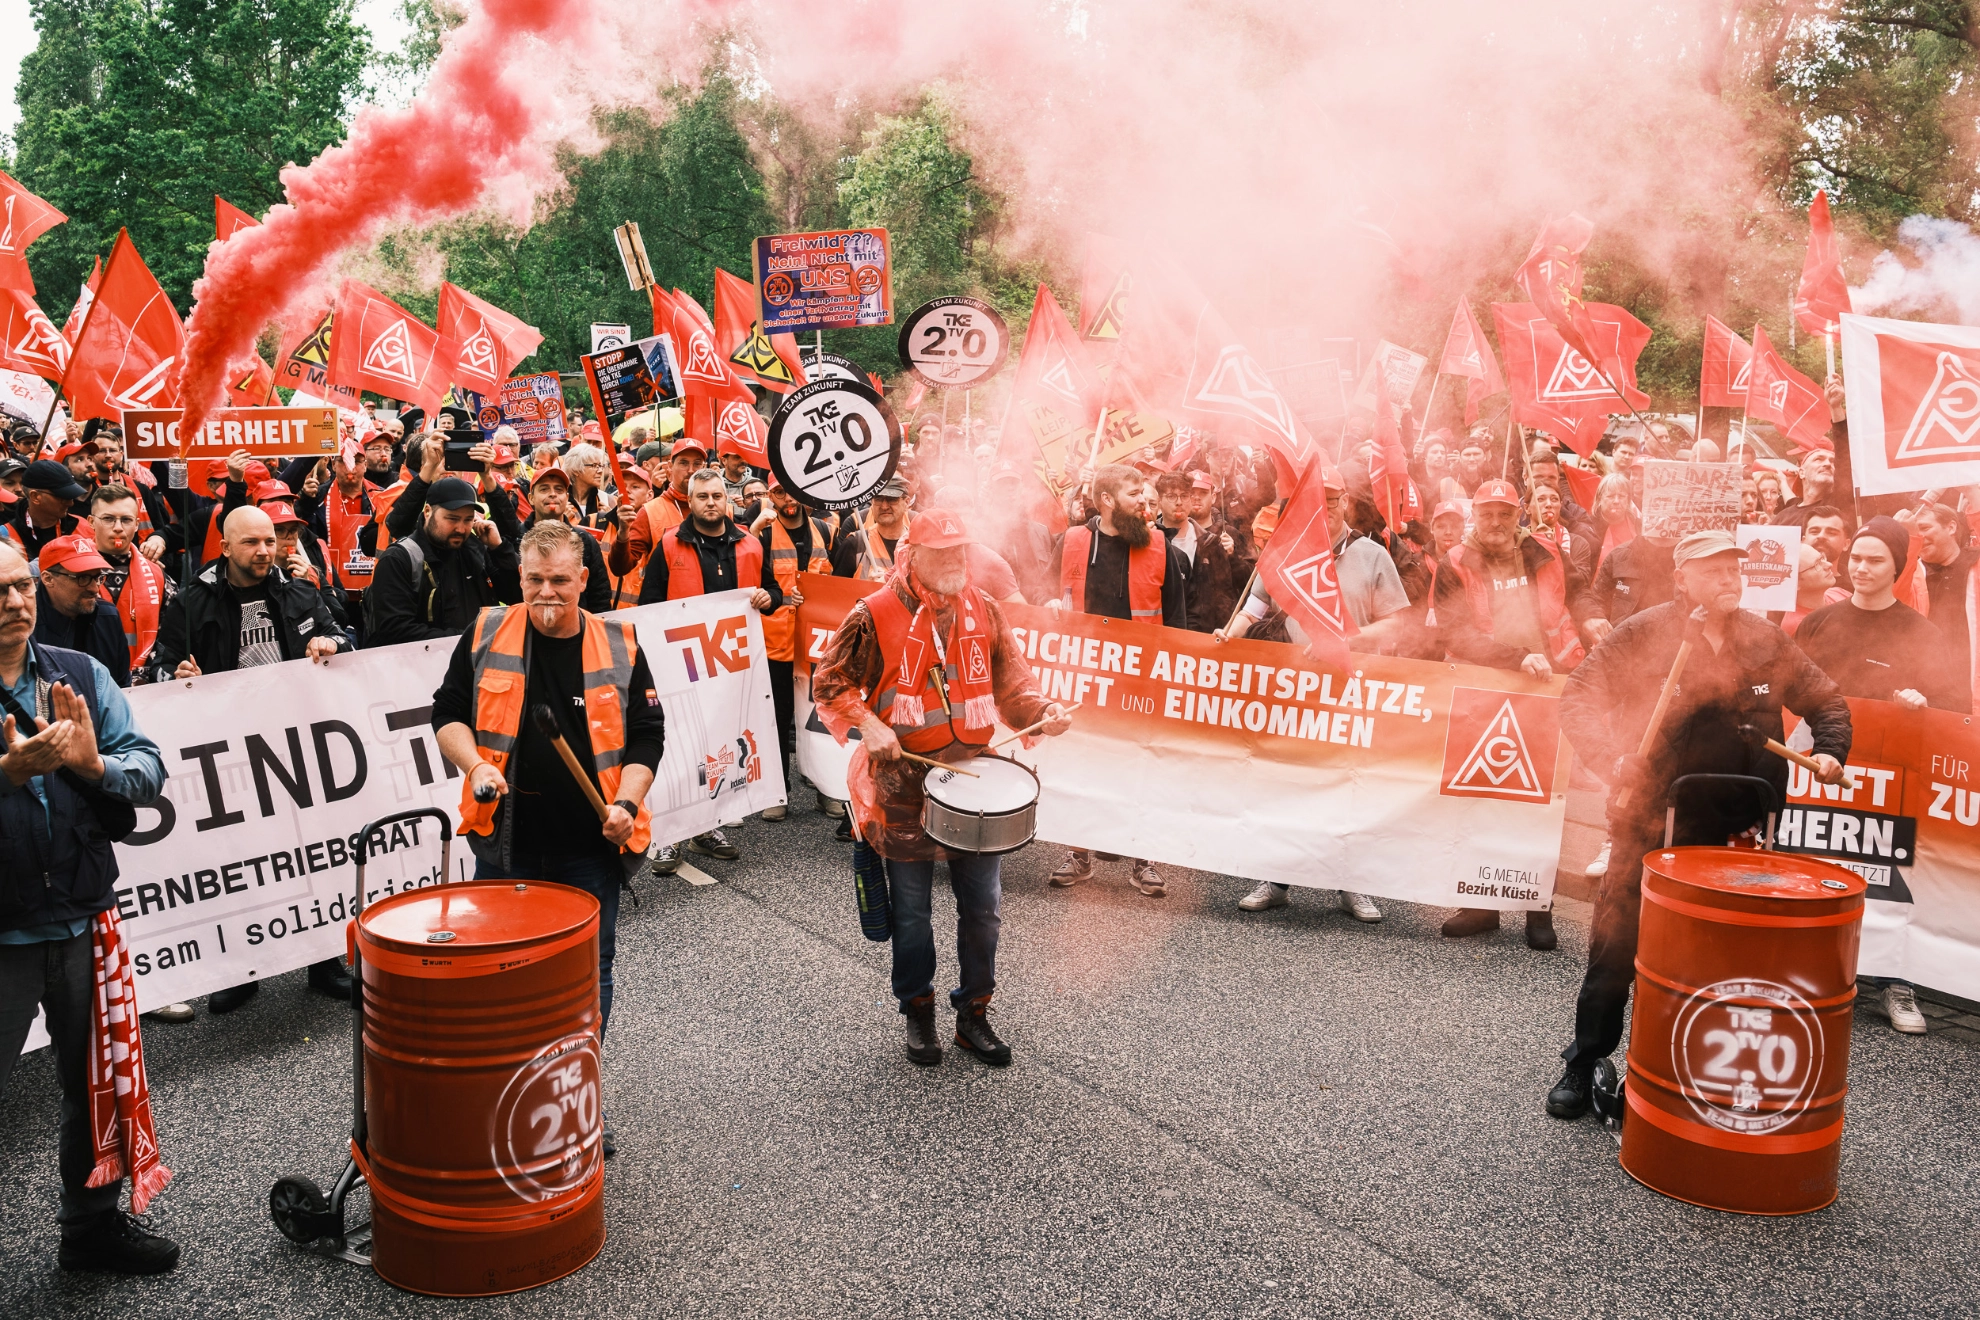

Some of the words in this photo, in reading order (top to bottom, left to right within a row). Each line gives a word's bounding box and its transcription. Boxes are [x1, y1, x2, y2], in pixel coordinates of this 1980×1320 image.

[770, 233, 872, 253] Freiwild???
[768, 255, 806, 269] Nein!
[810, 252, 849, 265] Nicht
[854, 250, 877, 261] mit
[800, 269, 846, 287] UNS
[790, 299, 805, 307] Wir
[807, 296, 844, 305] kämpfen
[805, 304, 855, 315] Tarifvertrag
[930, 298, 952, 308] TEAM
[954, 298, 988, 311] ZUKUNFT
[763, 316, 806, 328] Sicherheit
[808, 315, 821, 324] für
[823, 313, 852, 322] unsere
[855, 310, 889, 318] Zukunft
[943, 313, 972, 327] TKE
[920, 326, 987, 358] 2.0
[948, 328, 964, 337] TV
[283, 361, 301, 378] IG
[595, 351, 622, 369] STOPP
[817, 355, 850, 368] UKUNFT
[502, 376, 549, 391] wild???
[510, 390, 536, 400] Nicht
[539, 387, 555, 396] mit
[781, 392, 803, 413] TEAM
[803, 381, 844, 395] ZUKUNFT
[504, 402, 536, 416] UNS
[803, 400, 840, 426] TKE
[818, 421, 837, 437] TV
[794, 412, 872, 475] 2.0
[824, 502, 848, 510] TEAM
[849, 500, 859, 508] IG
[858, 478, 888, 504] METALL
[1743, 562, 1791, 573] ARBEITSKAMPF
[664, 615, 750, 682] TKE
[808, 628, 835, 659] Z
[1011, 627, 1142, 676] SICHERE
[1752, 684, 1769, 695] TKE
[1121, 693, 1155, 714] UND
[1163, 688, 1375, 748] EINKOMMEN
[385, 705, 459, 786] T
[1931, 754, 1969, 782] FÜR
[1928, 781, 1980, 827] ZU
[1778, 808, 1907, 859] HERN.
[1478, 866, 1491, 880] IG
[1493, 867, 1541, 886] METALL
[1456, 881, 1498, 897] Bezirk
[1501, 884, 1539, 901] Küste
[134, 939, 201, 976] sam
[1726, 1006, 1771, 1030] TKE
[1735, 1031, 1763, 1050] TV
[1703, 1028, 1797, 1084] 2.0
[546, 1060, 582, 1096] TKE
[559, 1090, 579, 1114] TV
[531, 1081, 597, 1156] 2.0
[1706, 1108, 1733, 1127] TEAM
[1748, 1113, 1788, 1130] METALL
